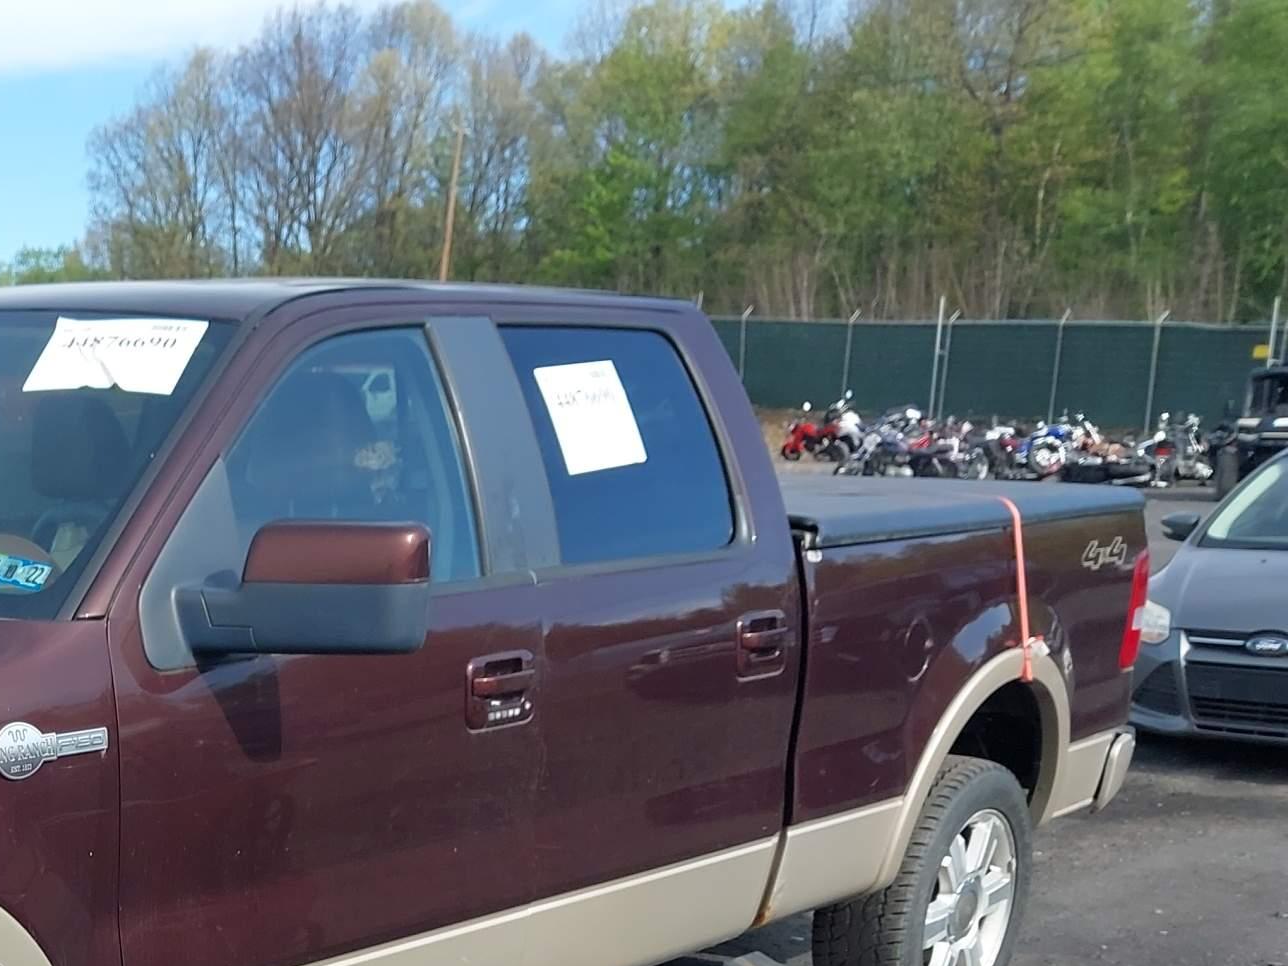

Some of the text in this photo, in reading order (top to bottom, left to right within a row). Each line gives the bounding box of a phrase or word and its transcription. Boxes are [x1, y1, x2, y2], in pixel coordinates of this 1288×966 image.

[1081, 536, 1127, 570] 4x4
[25, 566, 44, 584] 22
[17, 737, 56, 761] RANCH
